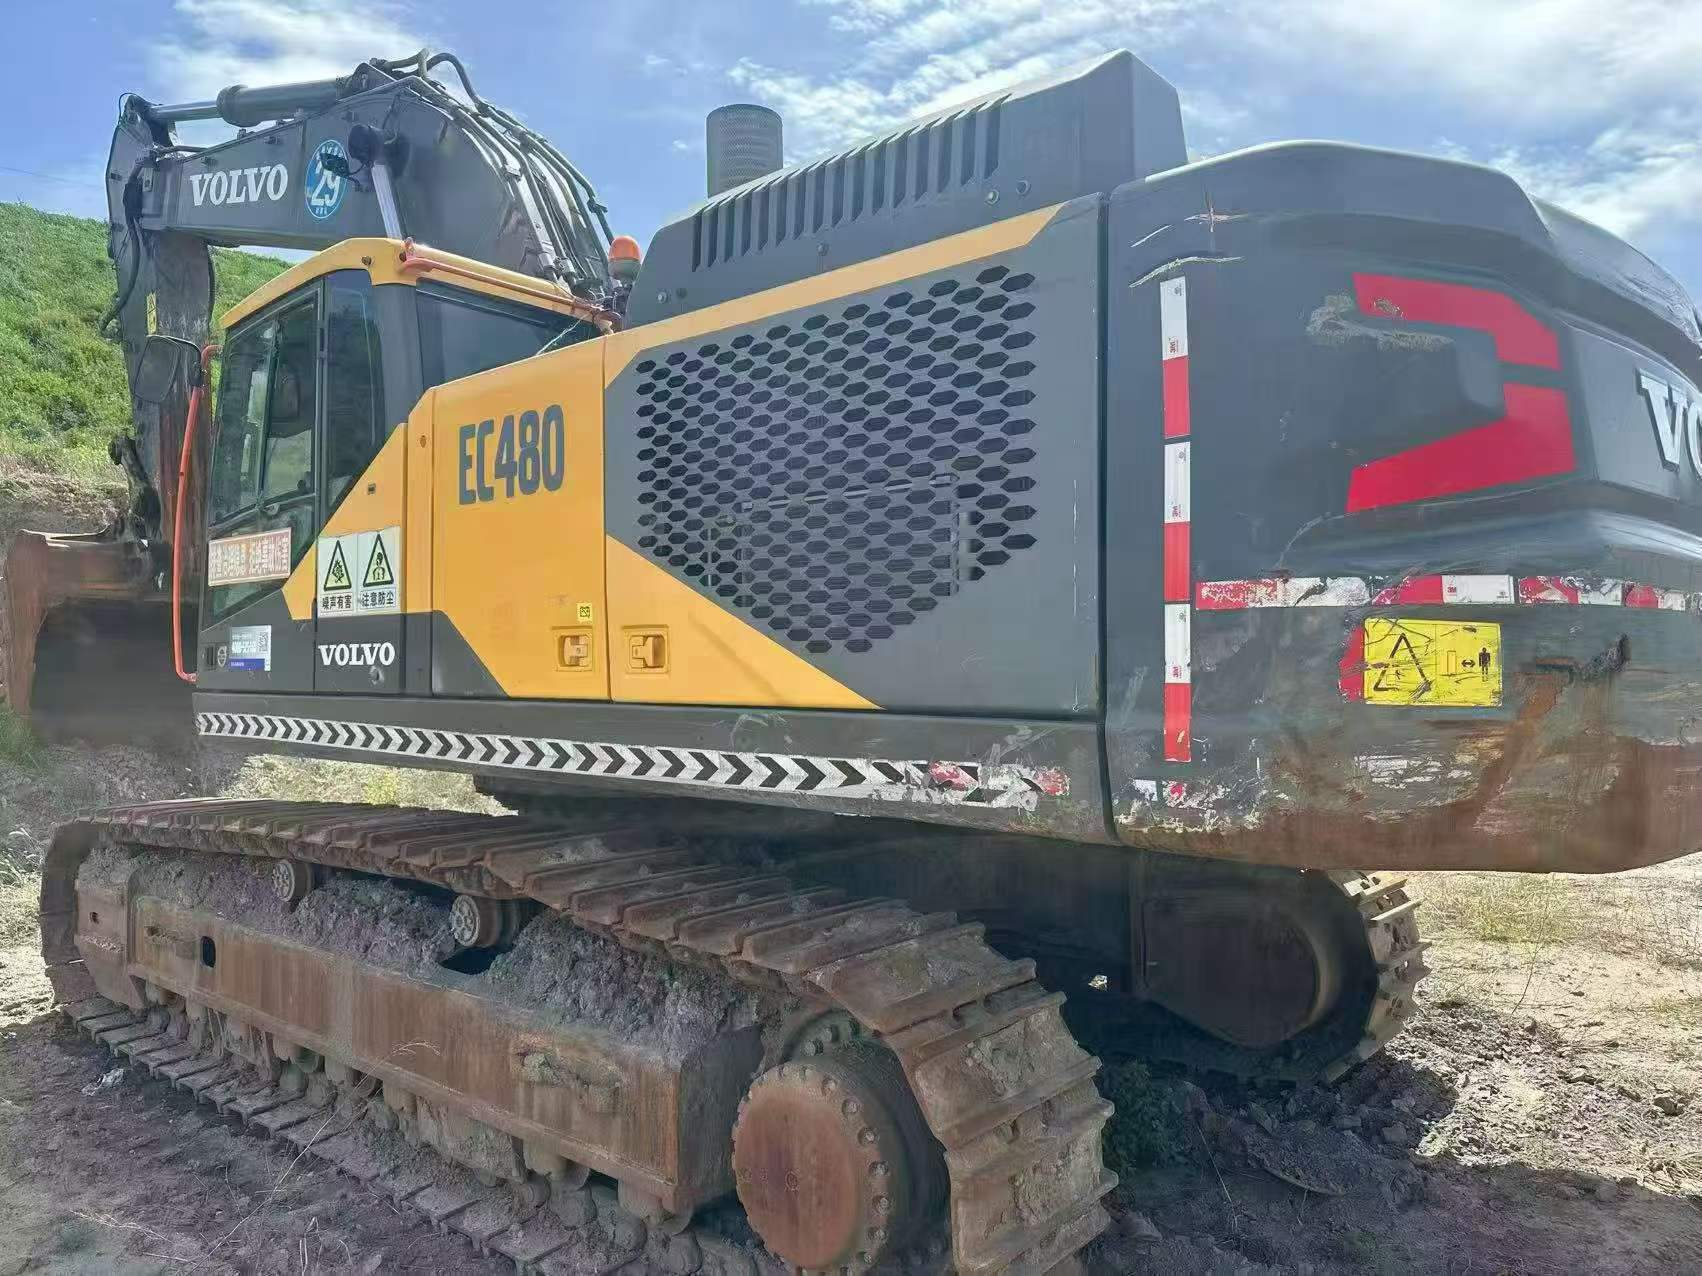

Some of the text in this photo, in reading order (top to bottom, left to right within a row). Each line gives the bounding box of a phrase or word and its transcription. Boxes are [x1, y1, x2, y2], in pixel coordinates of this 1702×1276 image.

[190, 163, 288, 207] VOLVO
[459, 404, 565, 505] EC480
[322, 594, 352, 610] 噪声有害
[362, 591, 394, 607] 注意防尘
[318, 642, 395, 666] VOLVO
